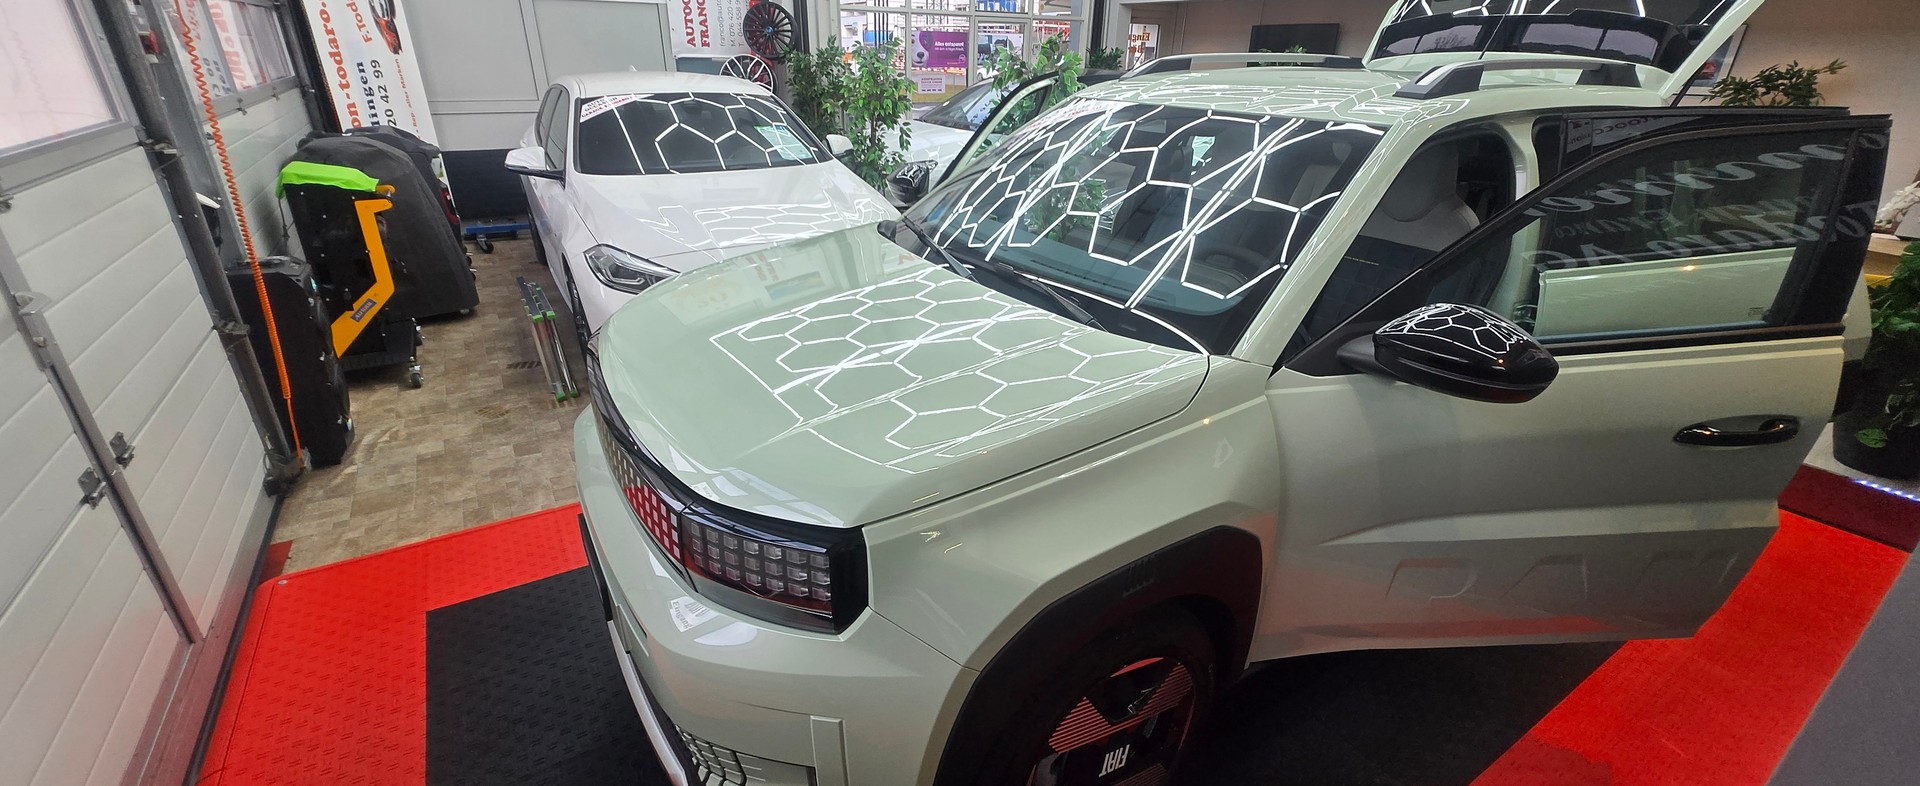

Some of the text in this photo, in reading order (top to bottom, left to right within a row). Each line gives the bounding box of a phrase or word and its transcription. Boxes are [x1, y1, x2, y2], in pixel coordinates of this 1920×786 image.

[370, 59, 384, 79] 99
[377, 84, 390, 104] 42
[1098, 743, 1131, 778] FIAT
